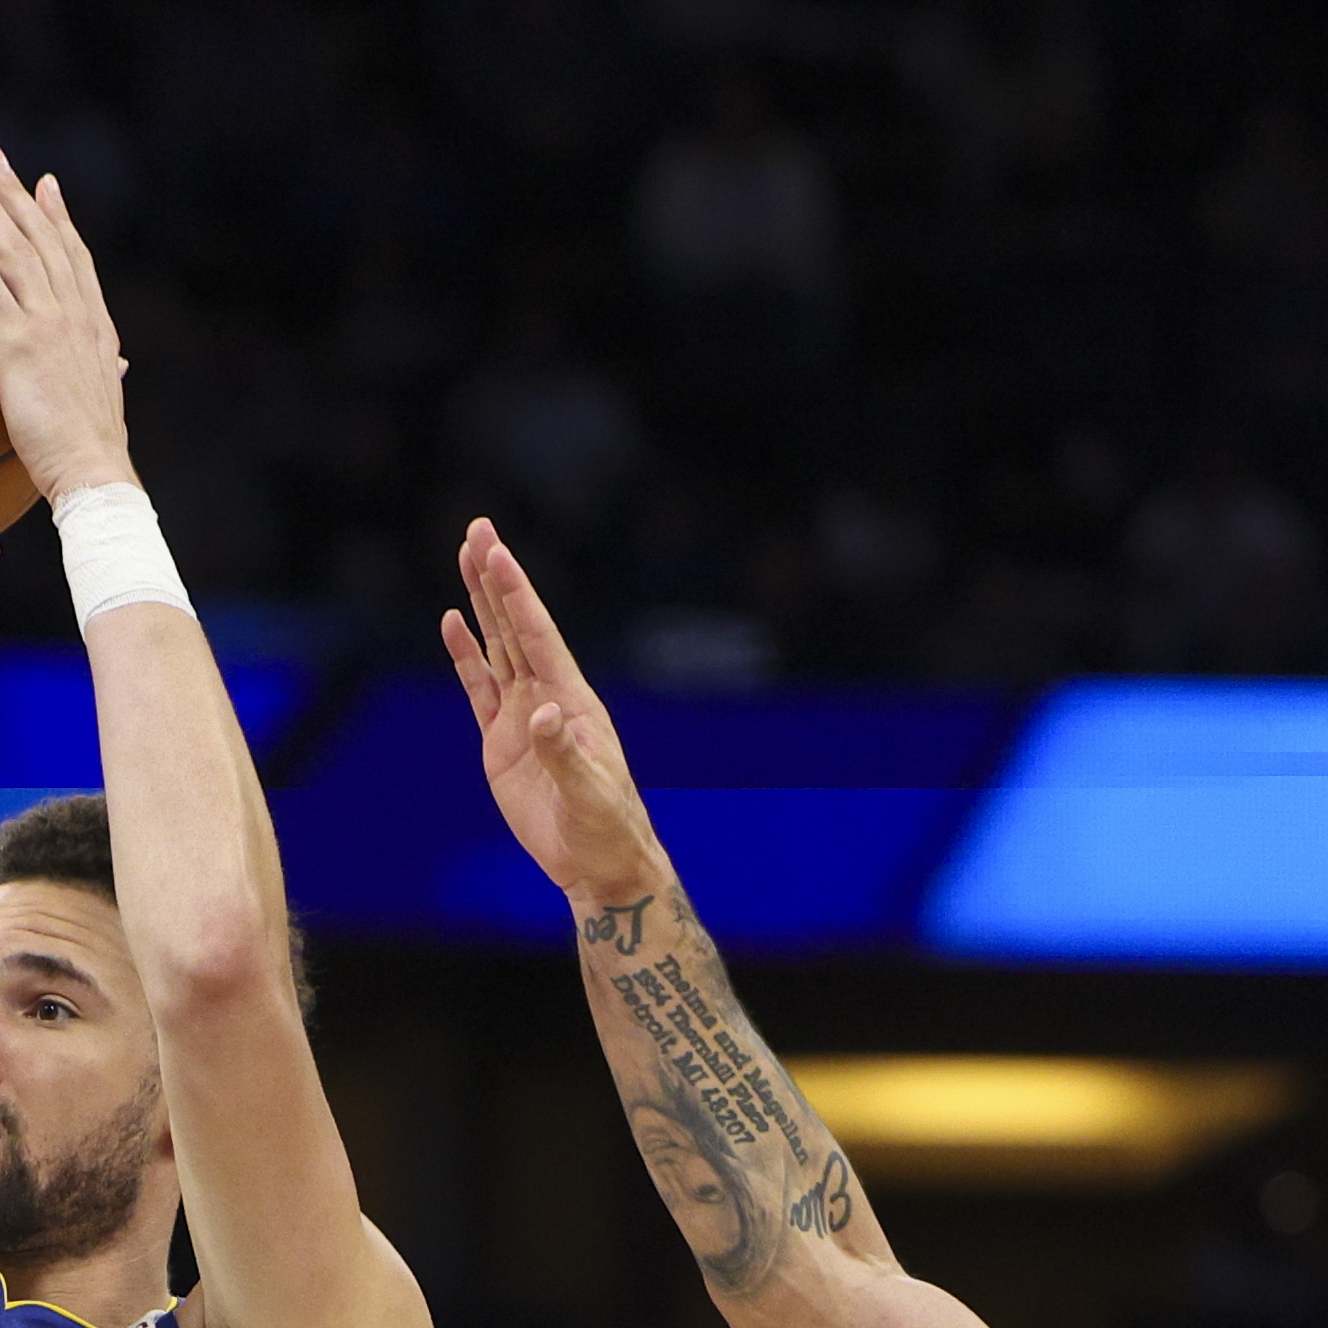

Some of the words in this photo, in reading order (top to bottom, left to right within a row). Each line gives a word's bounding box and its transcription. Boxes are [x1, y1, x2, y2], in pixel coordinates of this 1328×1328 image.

[714, 1030, 751, 1071] and
[672, 1051, 709, 1088] MI
[701, 1087, 756, 1144] 48207
